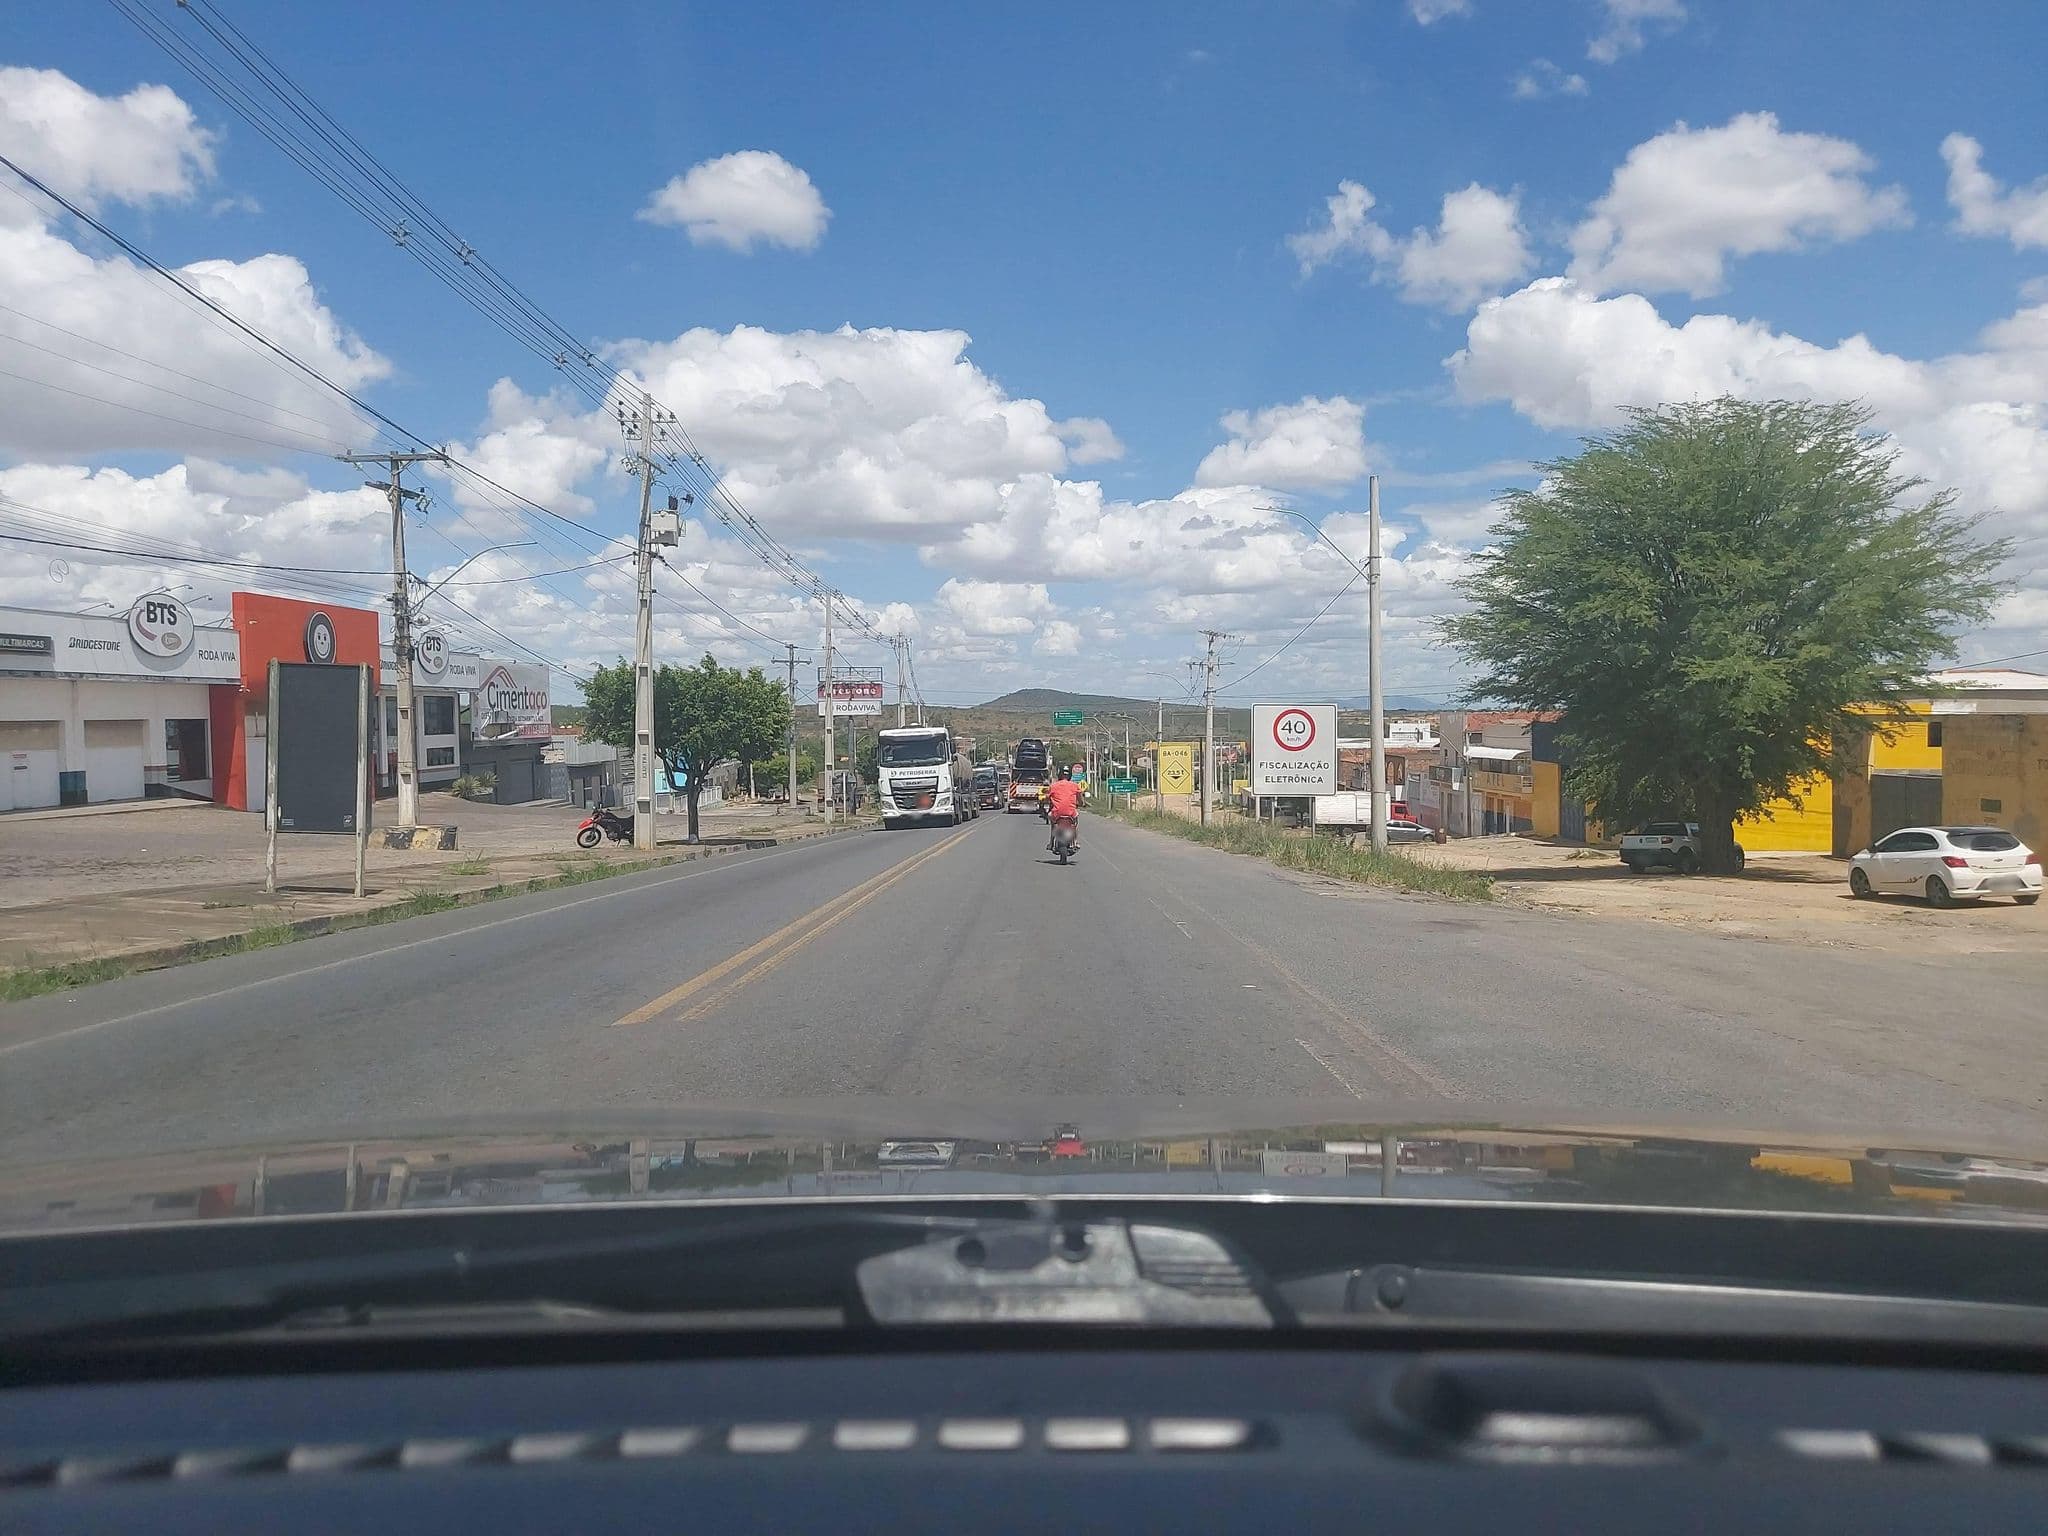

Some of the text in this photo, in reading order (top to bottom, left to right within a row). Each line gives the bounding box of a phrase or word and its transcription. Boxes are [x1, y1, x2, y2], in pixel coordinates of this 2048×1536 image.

[146, 601, 177, 625] BTS
[198, 650, 236, 662] RODA VIVA
[836, 704, 876, 712] RODAVIVA
[1281, 720, 1306, 734] 40
[1259, 760, 1330, 771] FISCALIZAÇÃO
[1265, 774, 1324, 784] ELETRÔNICA
